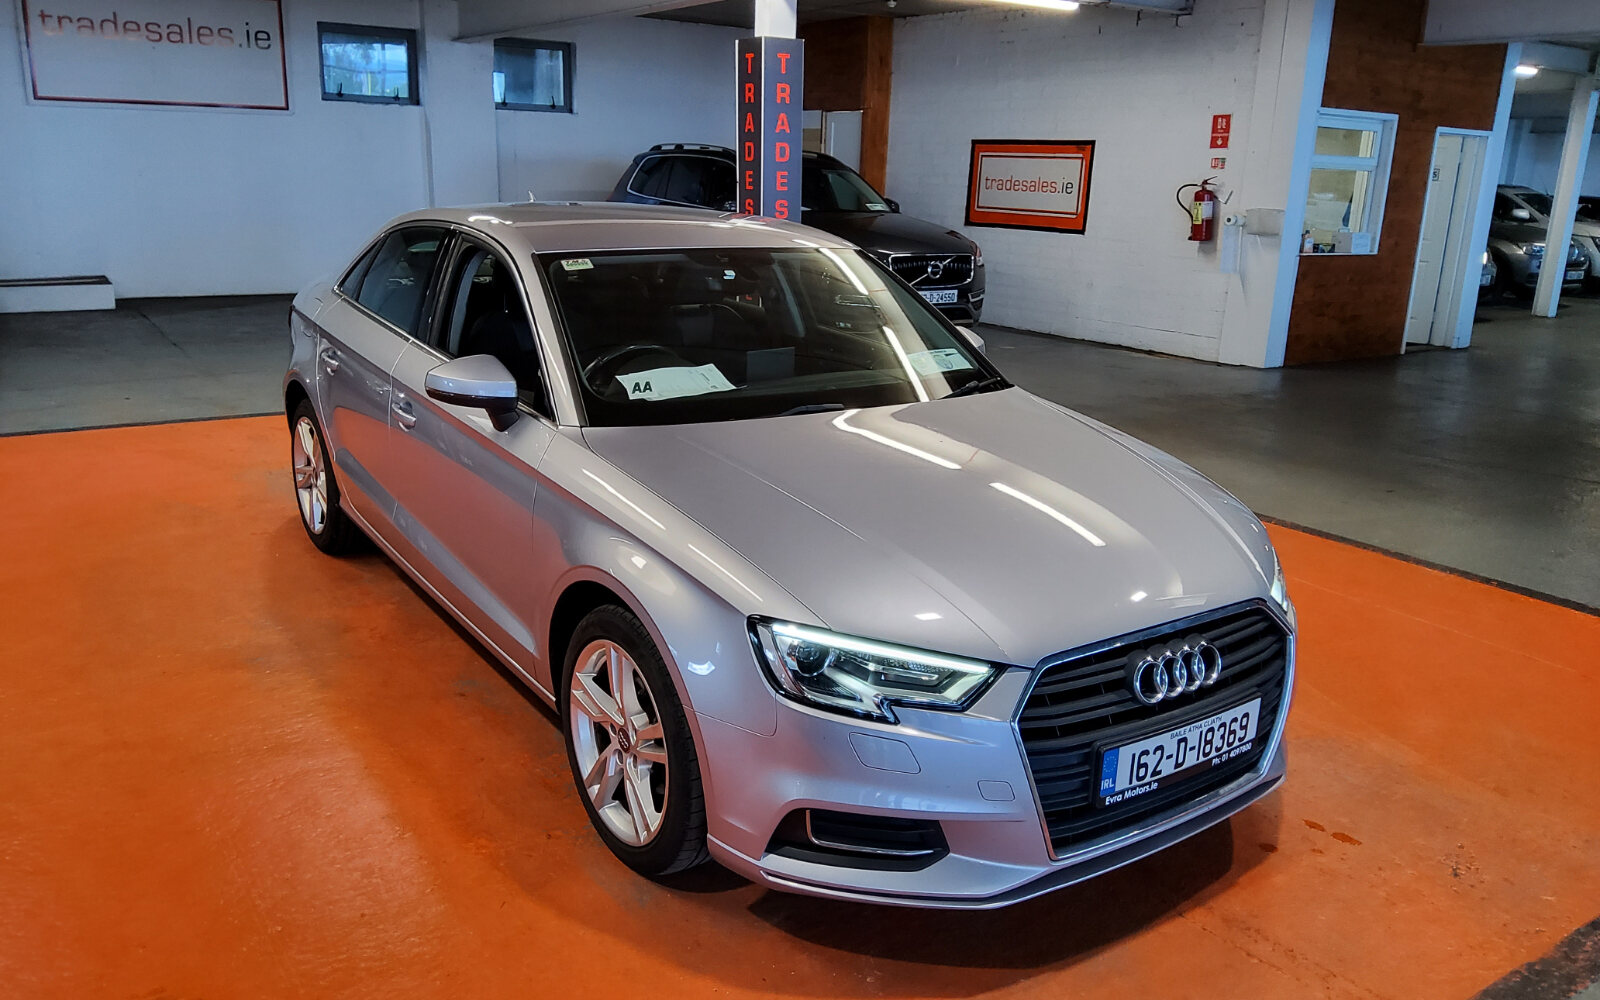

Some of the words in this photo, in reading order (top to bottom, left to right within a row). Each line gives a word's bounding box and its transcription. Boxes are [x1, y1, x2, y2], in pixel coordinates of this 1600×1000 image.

[38, 9, 271, 50] tradesales.ie
[744, 53, 754, 215] TRADES
[775, 53, 790, 219] TRADES
[984, 176, 1074, 195] tradesales.ie
[632, 381, 653, 394] AA
[1170, 729, 1187, 740] BAILE
[1203, 716, 1223, 728] CLIATH
[1128, 712, 1250, 785] 162-D-18369
[1100, 778, 1114, 790] IRL
[1105, 794, 1122, 806] Evra
[1123, 781, 1158, 800] Motors.ie
